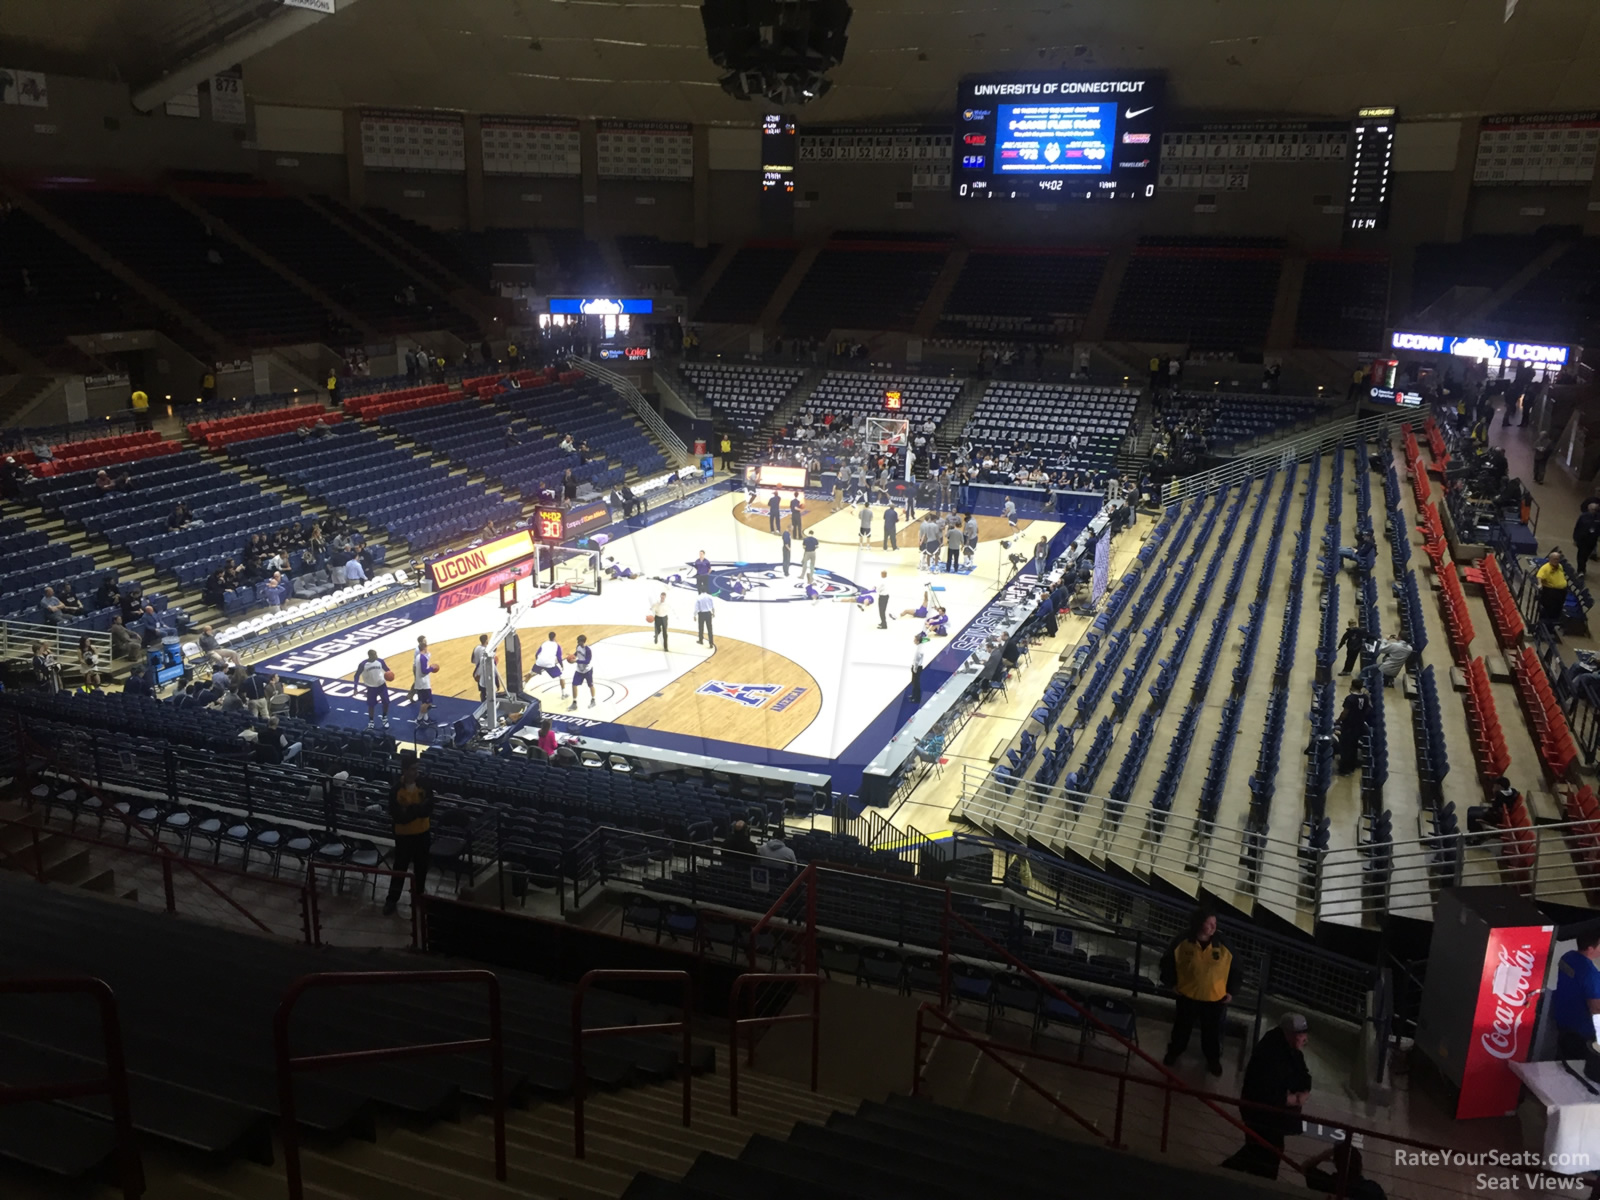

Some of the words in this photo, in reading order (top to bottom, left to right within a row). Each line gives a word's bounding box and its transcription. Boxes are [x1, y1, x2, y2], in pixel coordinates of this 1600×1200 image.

[215, 79, 238, 94] 873
[974, 84, 1041, 96] UNIVERSITY
[1043, 83, 1059, 94] OF
[1060, 81, 1146, 94] CONNECTICUT
[802, 148, 814, 158] 24
[841, 148, 851, 158] 21
[859, 148, 871, 158] 52
[878, 148, 890, 158] 42
[898, 148, 908, 158] 25
[1305, 145, 1316, 156] 31
[1330, 145, 1341, 156] 14
[1039, 180, 1063, 191] 44:02
[1230, 175, 1244, 186] 23
[960, 184, 968, 196] 0
[1145, 184, 1154, 197] 0
[1351, 219, 1376, 229] 11:14
[625, 347, 648, 357] Coke
[1393, 333, 1444, 351] UCONN
[1507, 344, 1567, 362] UCONN
[888, 398, 898, 408] 30
[541, 512, 562, 522] 44:02
[543, 521, 559, 538] 30
[435, 551, 487, 583] UCONN
[265, 616, 413, 672] HUSKIES
[770, 687, 808, 712] AMERICAN
